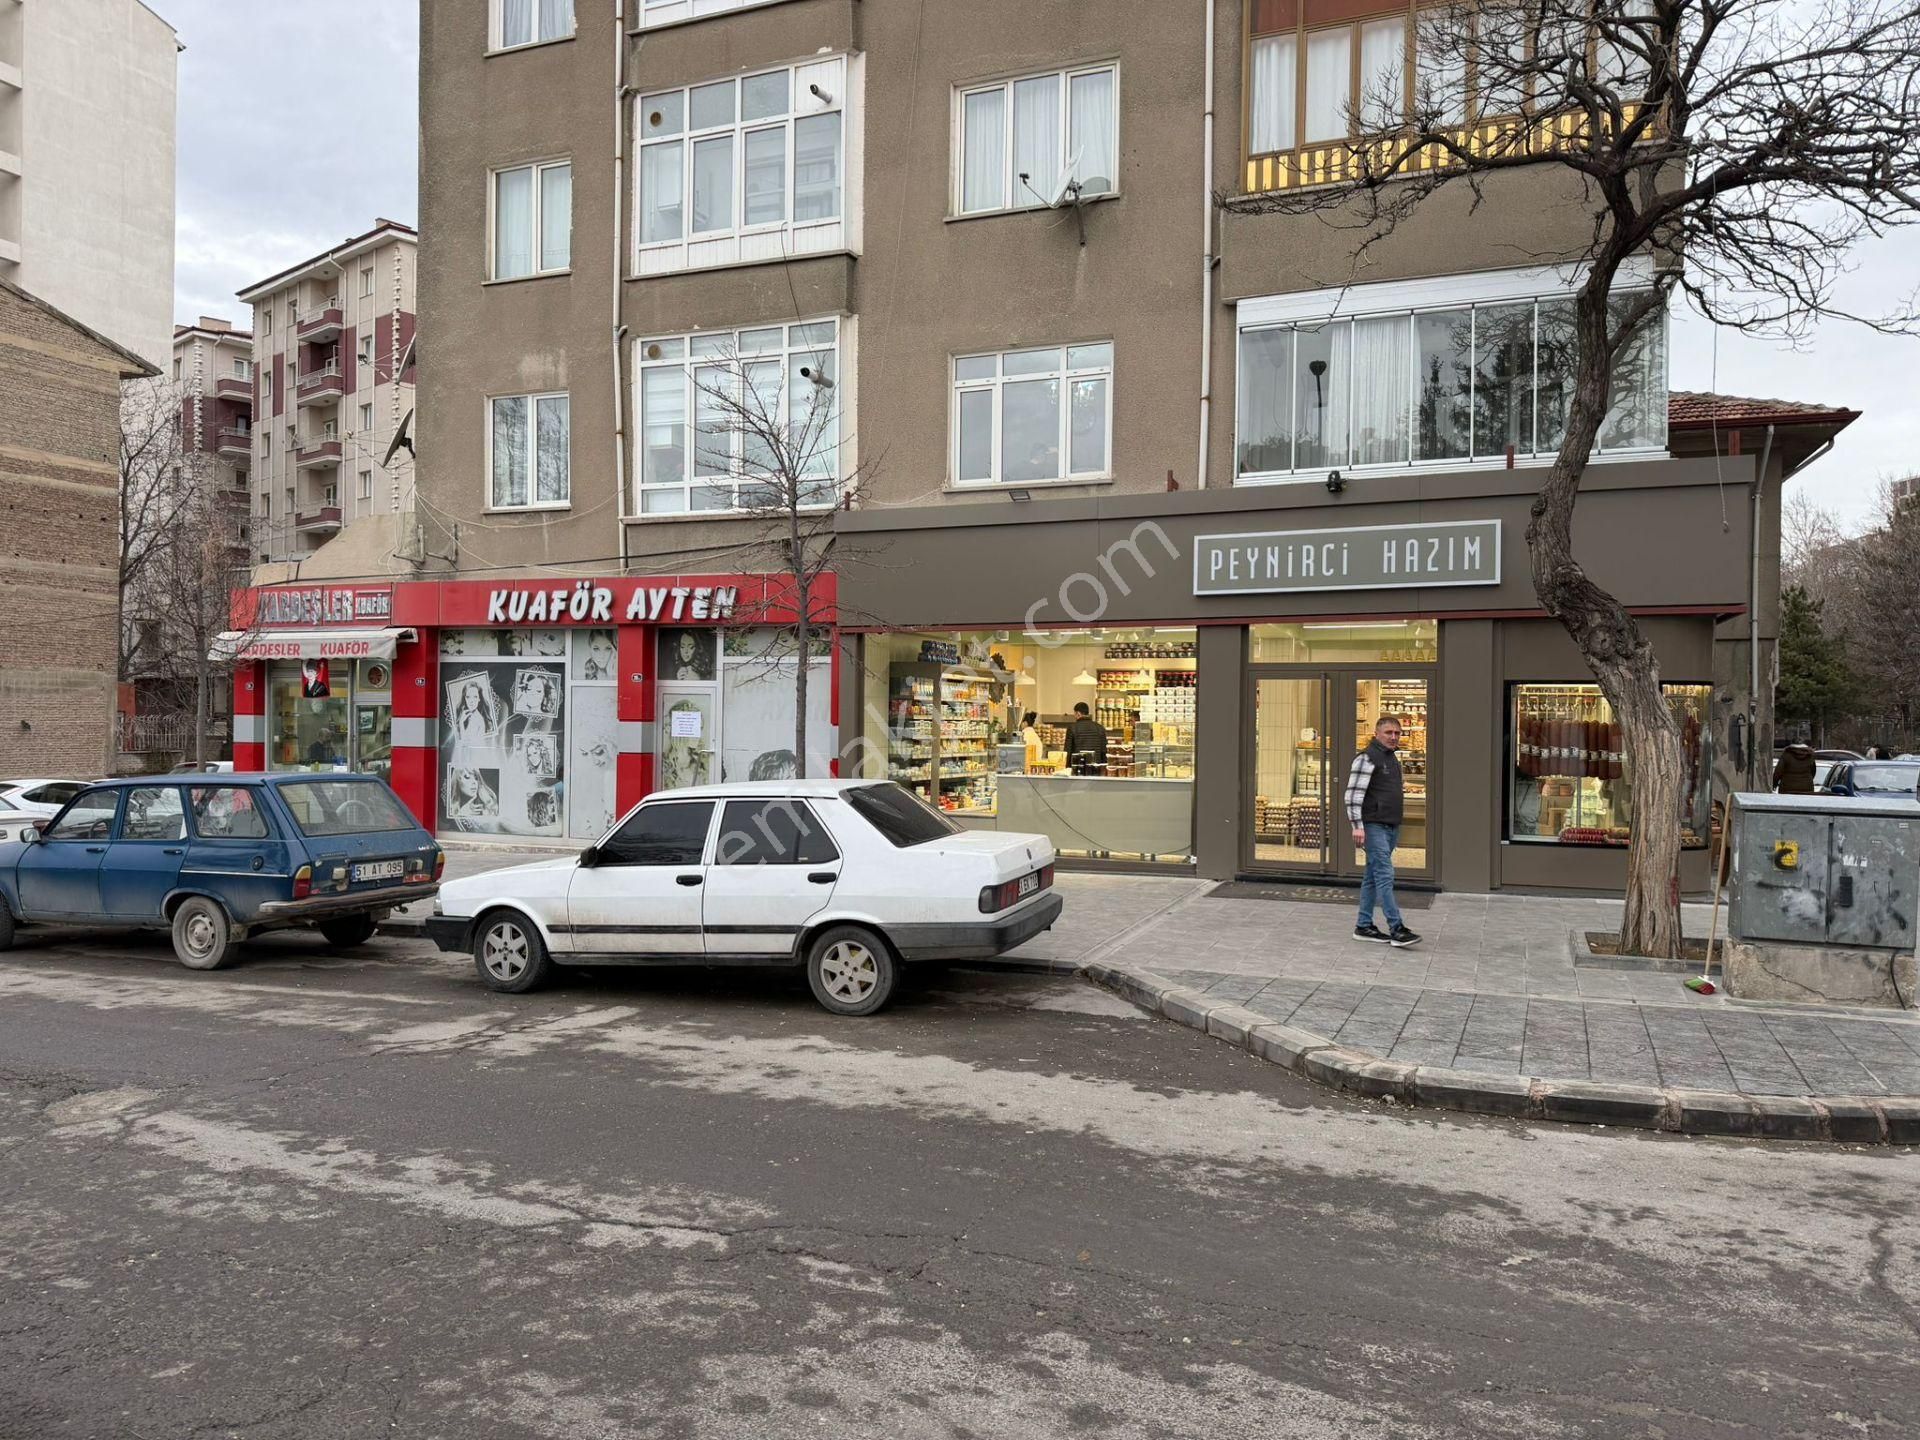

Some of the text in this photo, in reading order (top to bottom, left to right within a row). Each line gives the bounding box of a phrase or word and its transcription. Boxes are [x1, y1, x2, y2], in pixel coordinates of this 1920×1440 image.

[1383, 535, 1481, 574] HAZIM
[355, 593, 390, 614] KUAFÖR
[487, 580, 738, 623] KUAFÖR AYTEN
[320, 640, 370, 656] KUAFÖR
[355, 865, 366, 877] 51
[372, 863, 382, 875] AT
